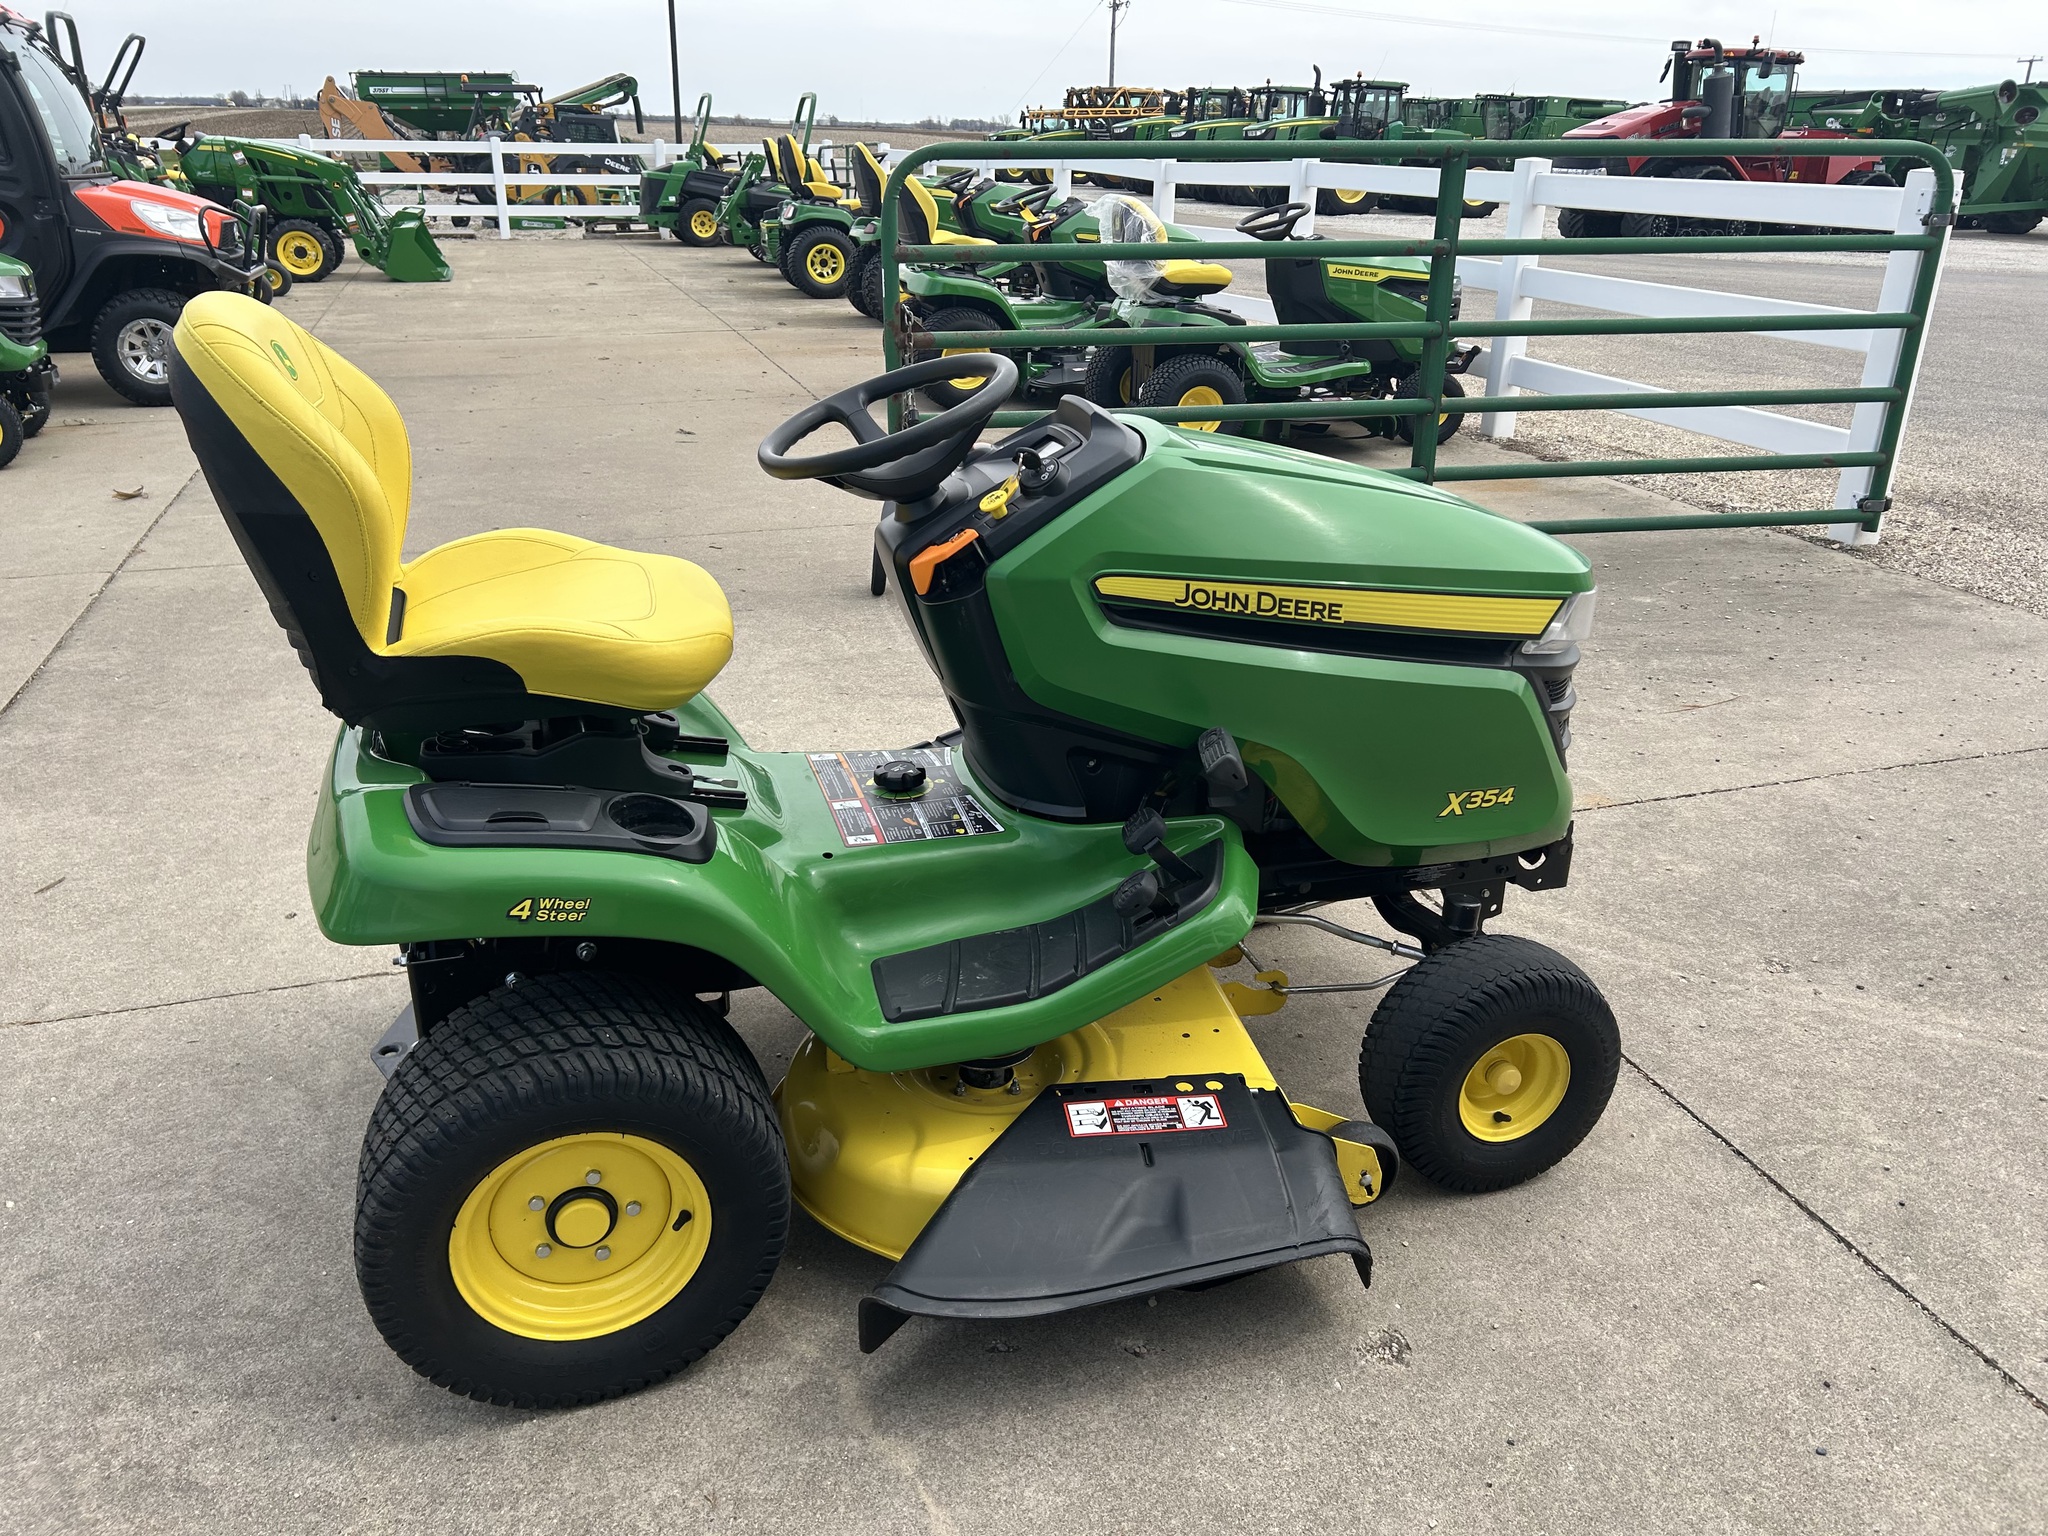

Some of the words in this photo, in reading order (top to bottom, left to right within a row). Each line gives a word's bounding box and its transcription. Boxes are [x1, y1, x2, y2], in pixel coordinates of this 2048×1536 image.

[604, 157, 631, 174] DEERE
[1332, 267, 1353, 276] JOHN
[1354, 269, 1379, 278] DEERE
[1174, 583, 1250, 613] JOHN
[1256, 591, 1345, 622] DEERE
[1437, 786, 1516, 818] X354
[508, 899, 533, 921] 4
[539, 898, 591, 910] Wheel
[536, 909, 587, 922] Steer
[1125, 1098, 1169, 1106] DANGER
